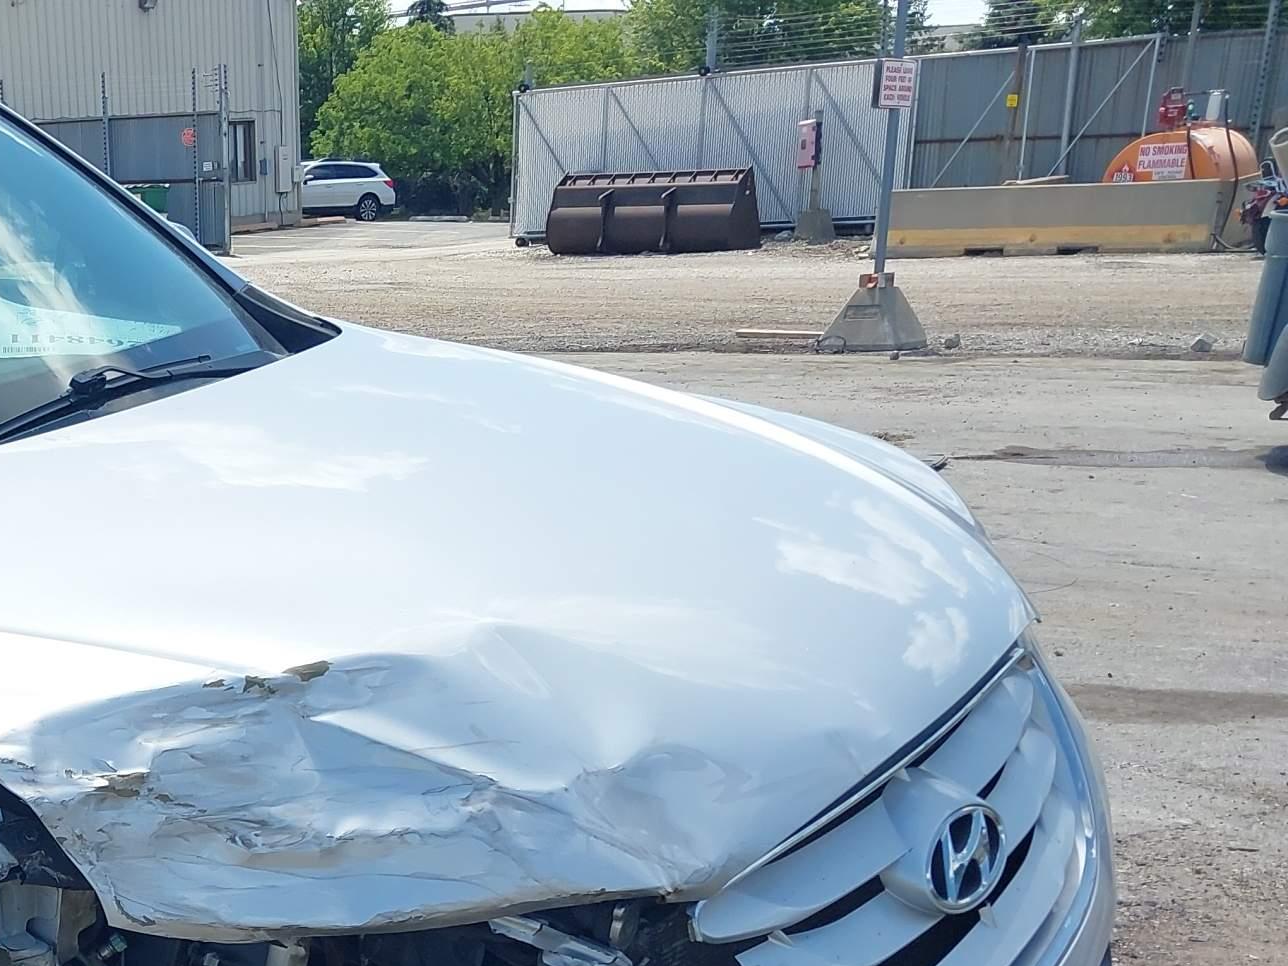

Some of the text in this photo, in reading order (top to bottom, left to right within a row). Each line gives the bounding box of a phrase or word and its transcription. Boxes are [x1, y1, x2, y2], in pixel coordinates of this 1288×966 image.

[1140, 144, 1188, 156] NO SMOKING
[1138, 158, 1185, 169] FLAMMABLE
